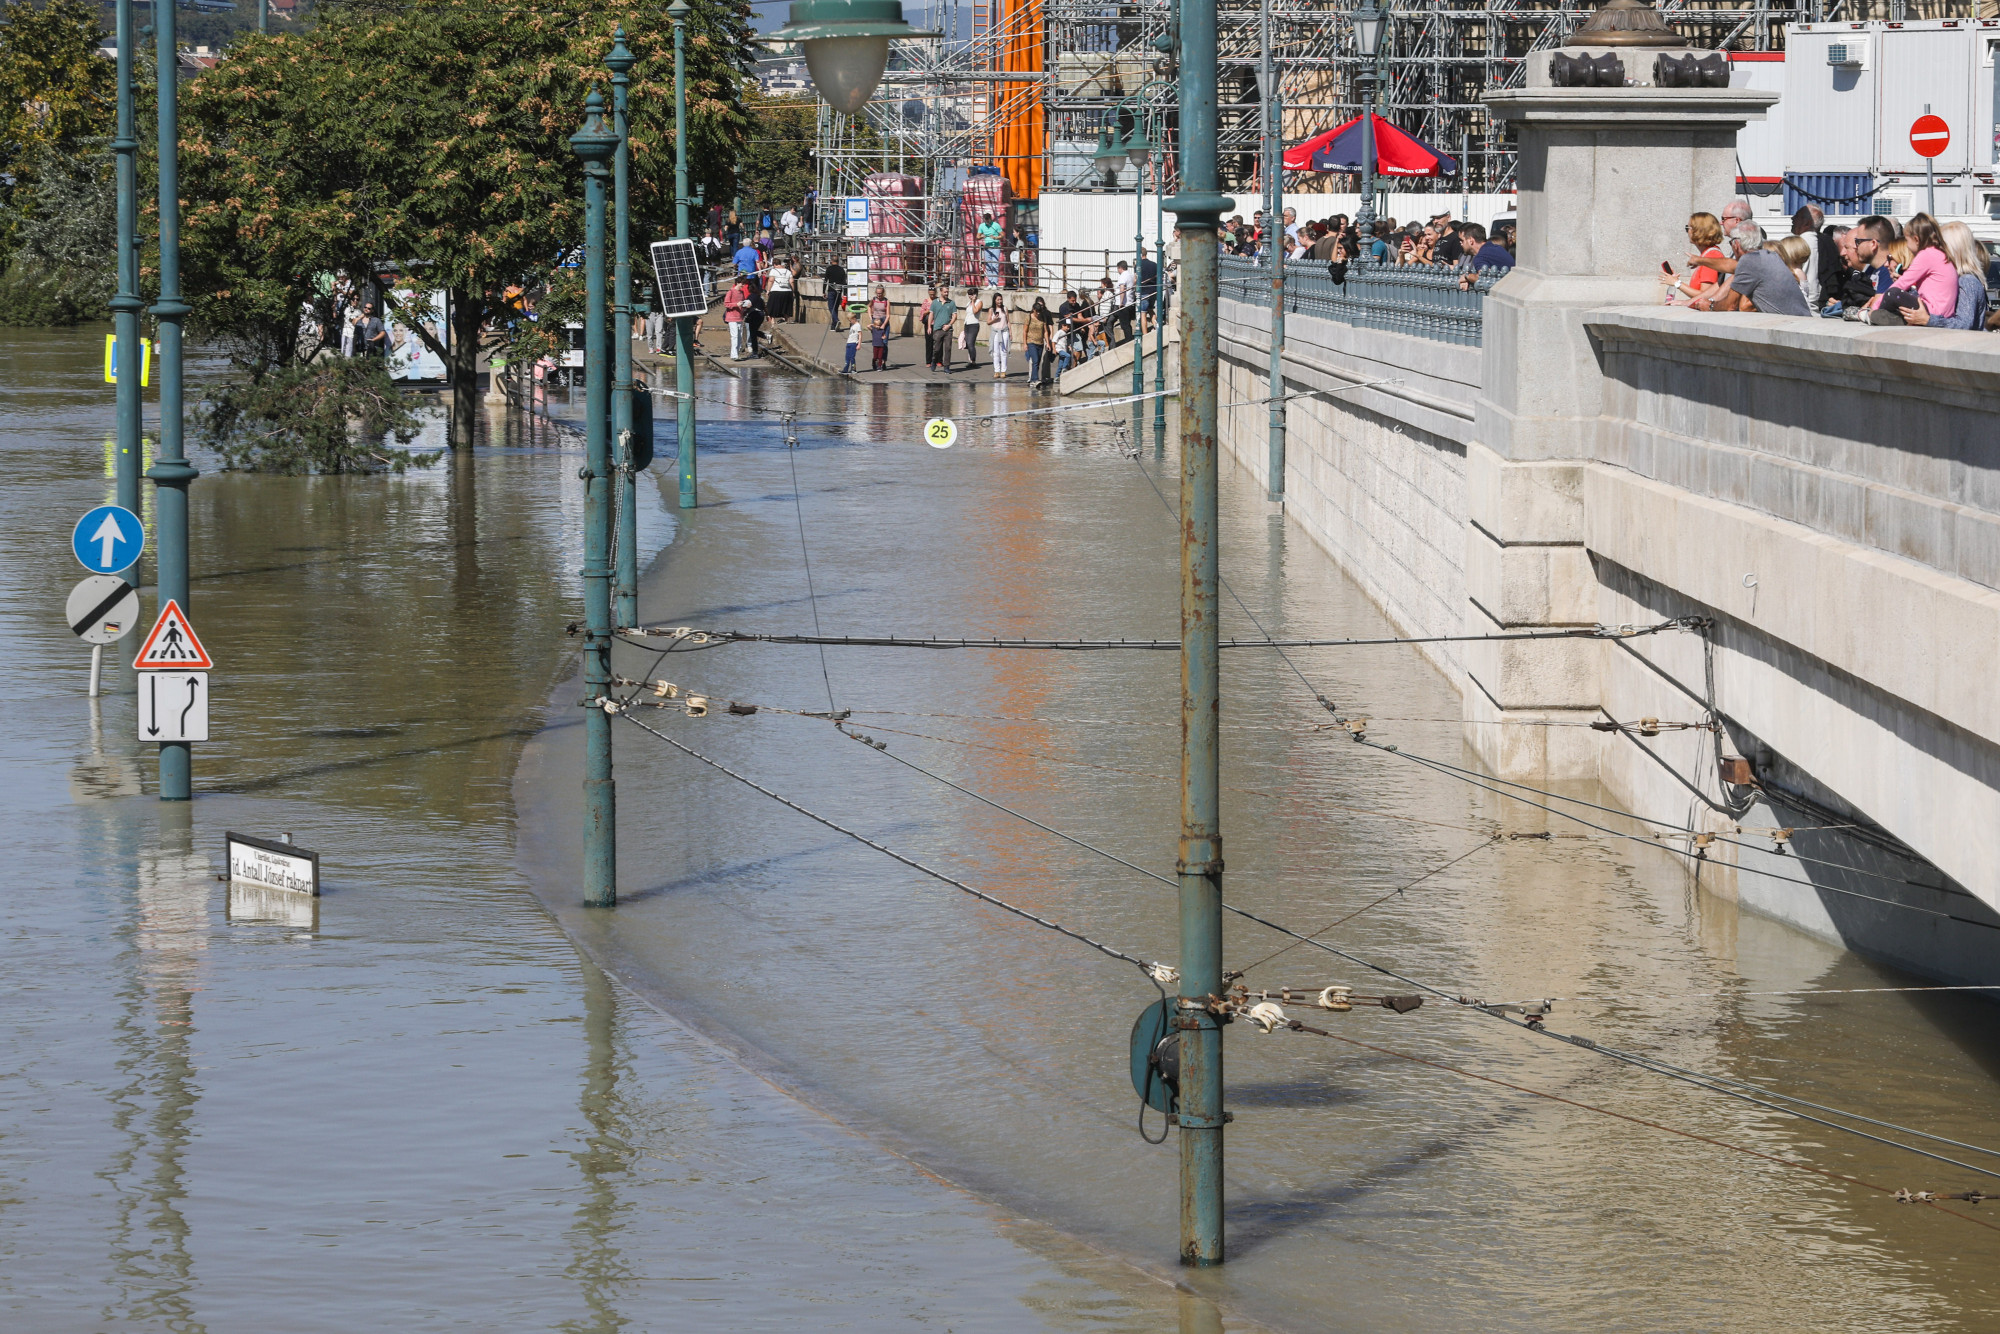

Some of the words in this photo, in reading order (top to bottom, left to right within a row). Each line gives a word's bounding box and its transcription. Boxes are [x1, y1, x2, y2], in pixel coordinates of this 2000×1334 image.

[931, 425, 949, 439] 25
[232, 857, 241, 876] id.
[242, 860, 263, 882] Antall
[264, 865, 285, 888] József
[286, 872, 312, 894] rakpart
